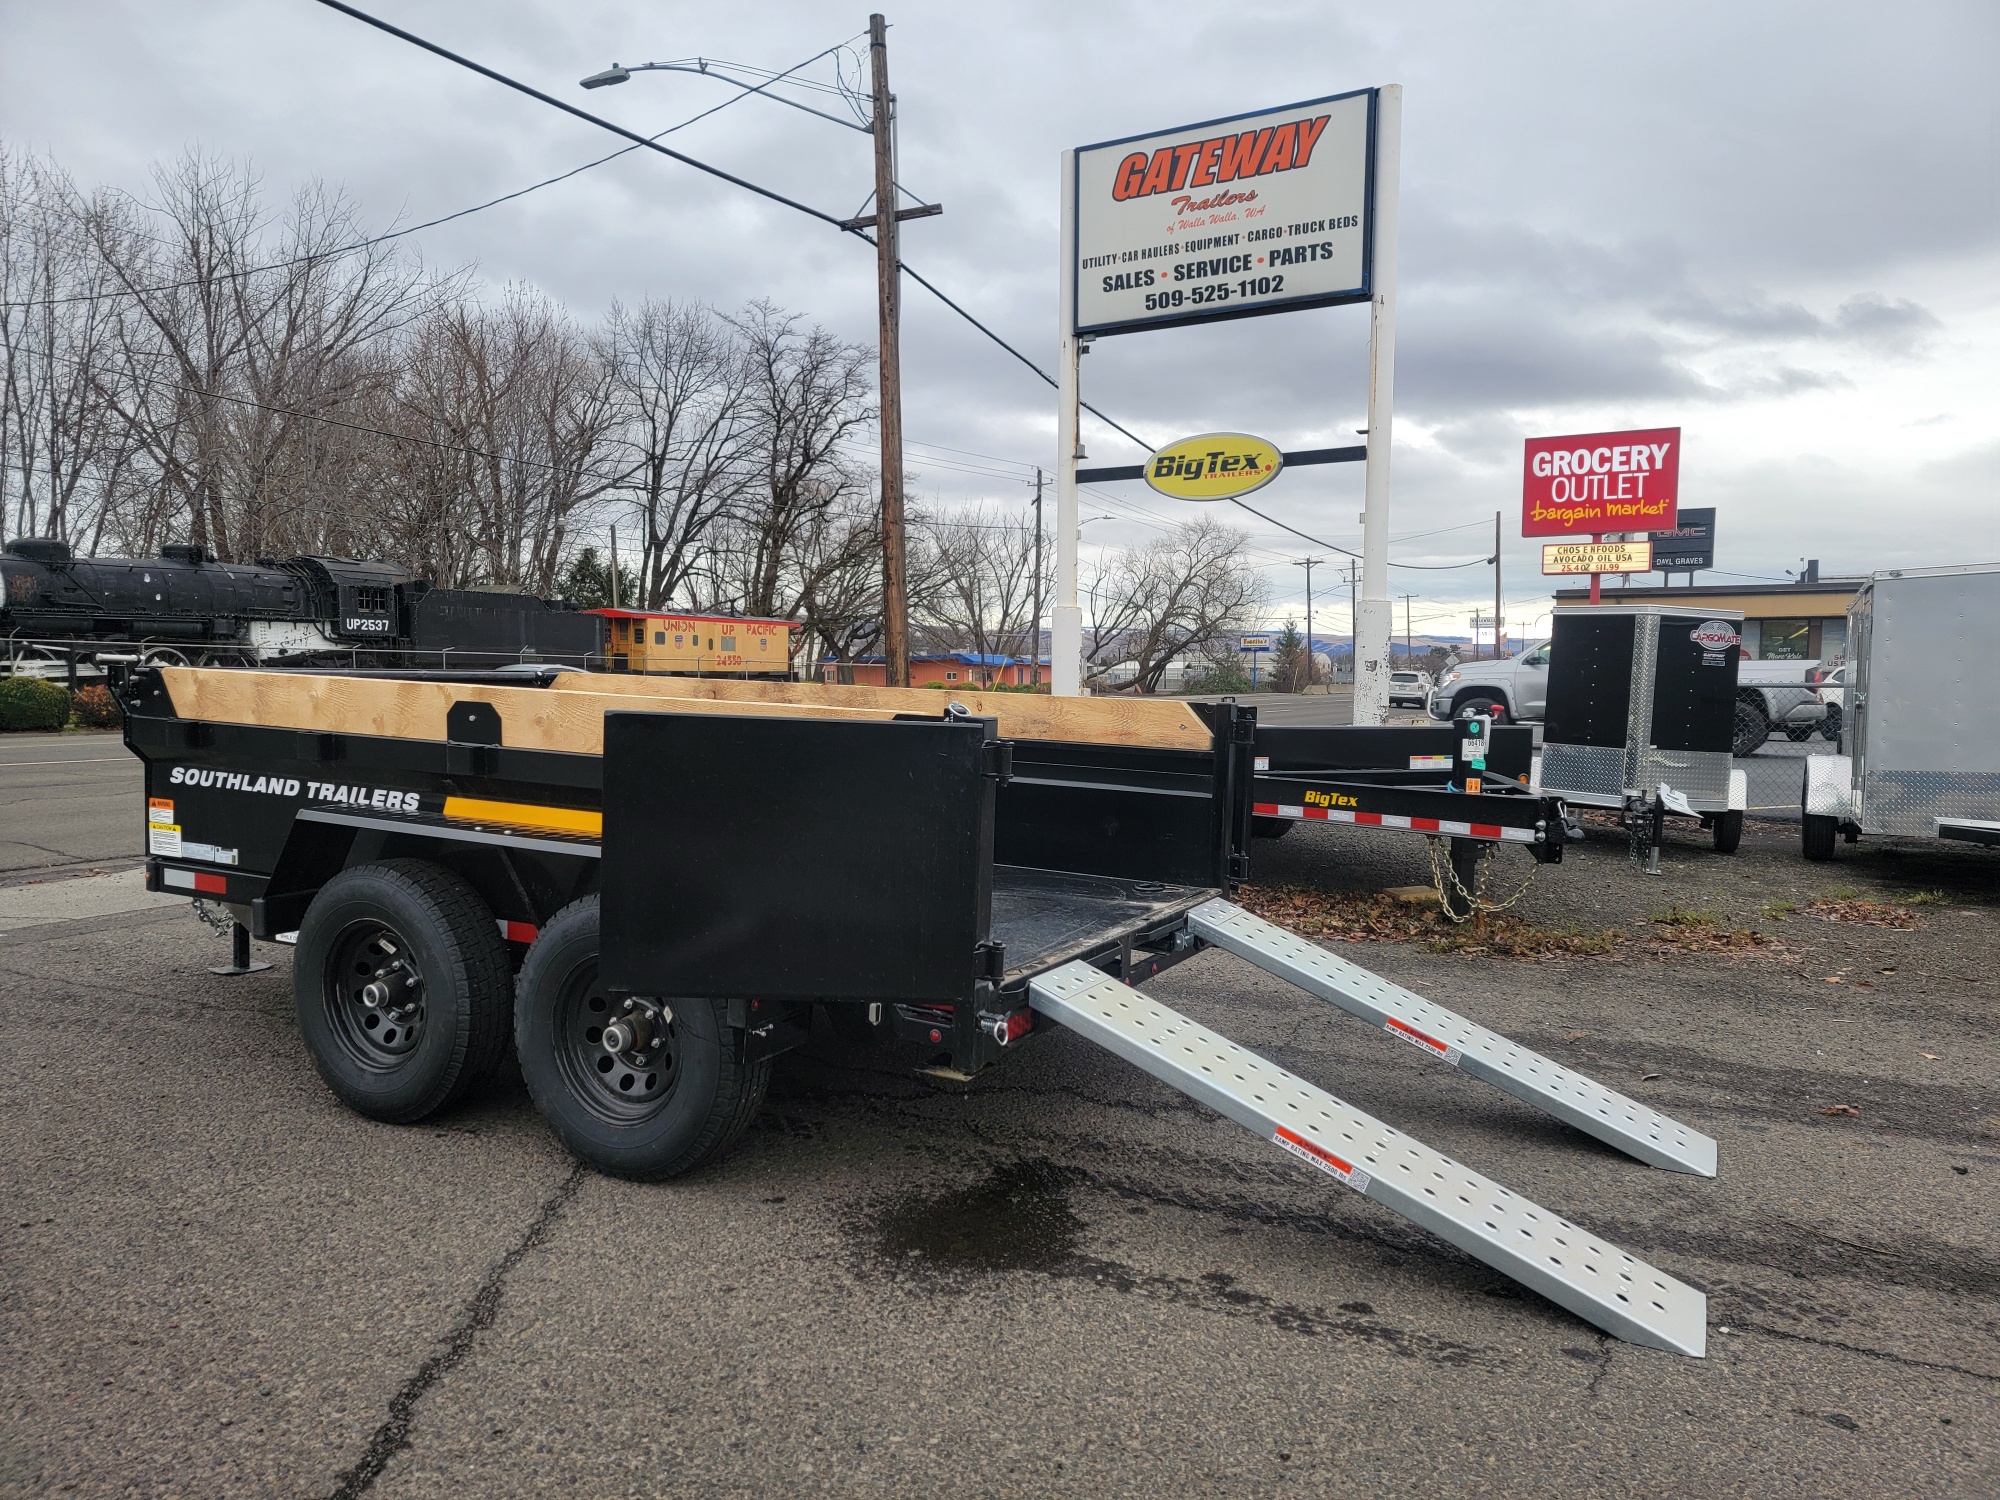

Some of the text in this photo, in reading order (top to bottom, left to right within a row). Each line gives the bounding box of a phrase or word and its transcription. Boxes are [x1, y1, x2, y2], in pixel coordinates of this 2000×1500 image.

[1112, 114, 1331, 201] GATEWAY
[1171, 189, 1258, 216] Trailers
[1166, 205, 1266, 235] of Walla Walla, WA
[1083, 215, 1358, 270] UTILITY CAR HAULERS EQUIPMENT CARGO TRUCK BEDS
[1102, 242, 1333, 293] SALES SERVICE PARTS
[1145, 275, 1284, 311] 509-525-1102
[1154, 452, 1263, 481] BigTex
[1532, 443, 1670, 477] GROCERY
[1203, 469, 1261, 480] TRAILERS
[1552, 472, 1650, 503] OUTLET
[1530, 499, 1669, 527] bargain market
[1553, 554, 1633, 563] AVOCADO OIL USA
[1596, 563, 1619, 571] $11.99
[346, 618, 389, 631] UP2537
[663, 620, 777, 636] UNION UP PACIFIC
[716, 655, 742, 666] 24550
[1767, 652, 1784, 660] More
[170, 766, 420, 810] SOUTHLAND TRAILERS
[1305, 790, 1358, 807] BigTex
[1274, 1135, 1289, 1147] RAMP
[1290, 1144, 1310, 1159] RATING
[1311, 1156, 1322, 1167] MAX
[1323, 1164, 1338, 1175] 2500
